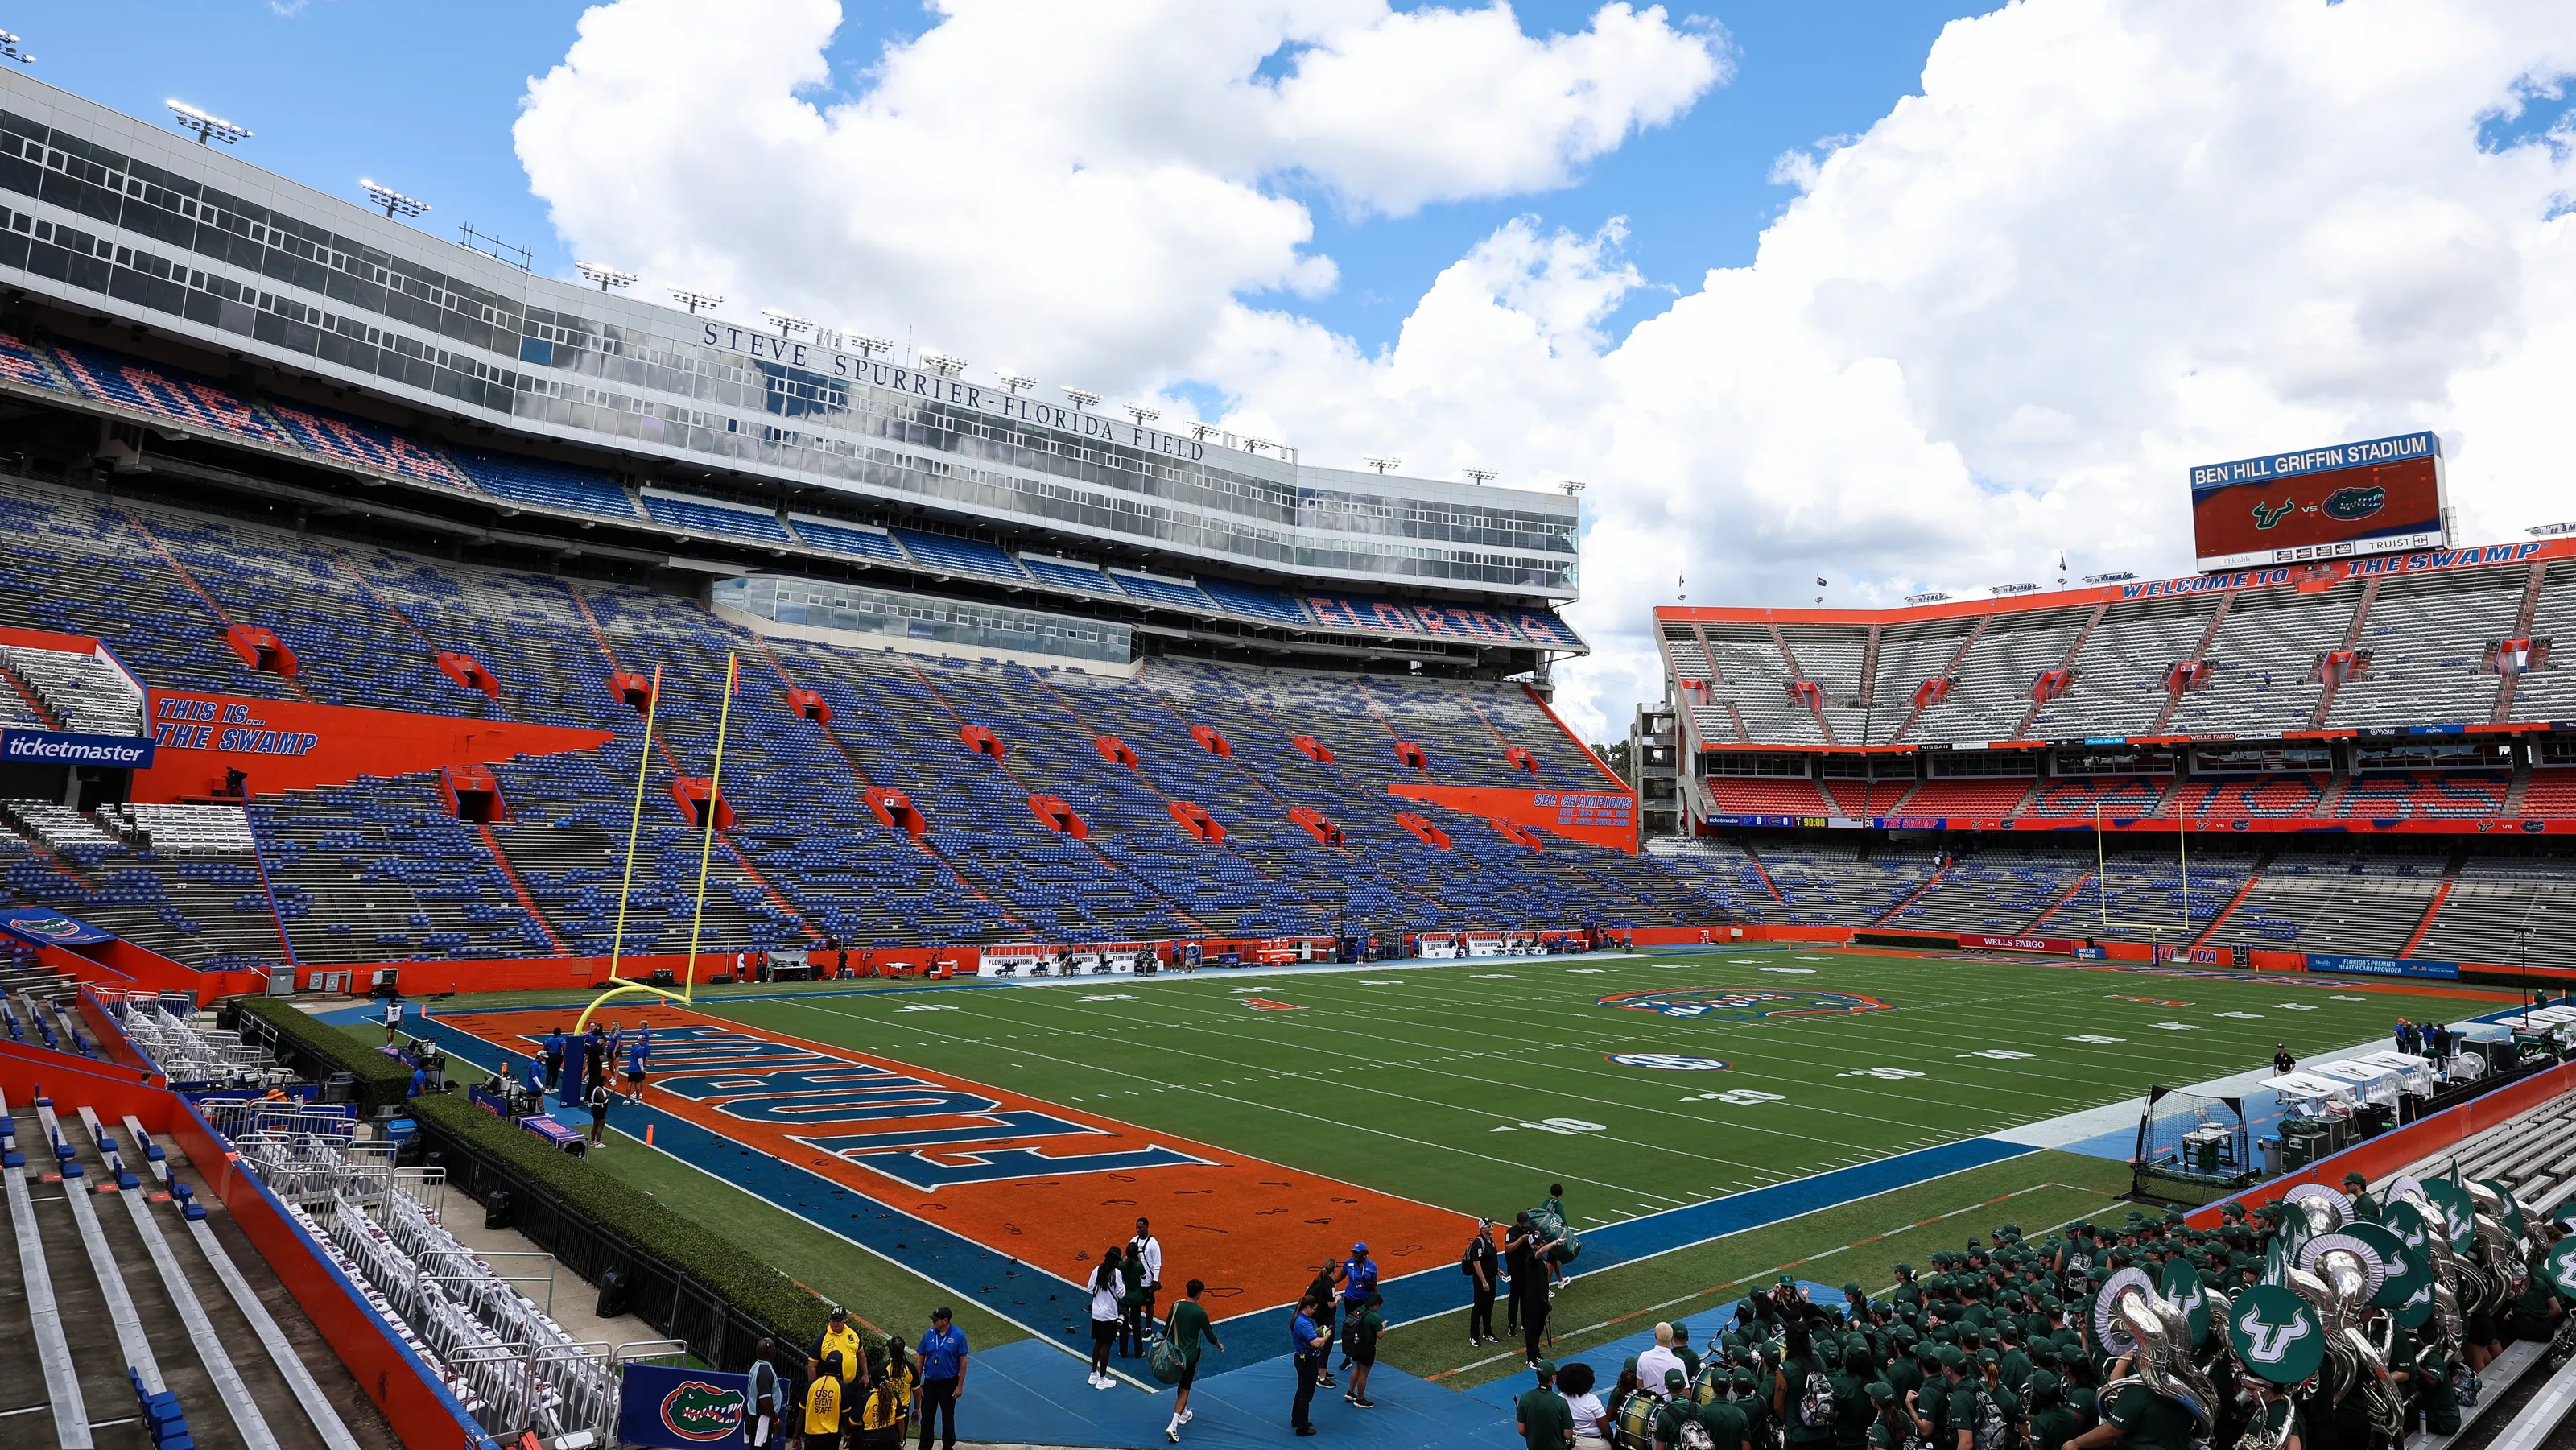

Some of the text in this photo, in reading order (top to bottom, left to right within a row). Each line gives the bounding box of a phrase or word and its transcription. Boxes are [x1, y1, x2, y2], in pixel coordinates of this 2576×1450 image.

[704, 322, 807, 366] STEVE
[1133, 427, 1204, 461] FIELD
[2195, 436, 2427, 485] BEN HILL GRIFFIN STADIUM
[2301, 505, 2318, 513] VS
[2368, 538, 2410, 550] TRUIST
[2122, 542, 2541, 600] WELCOME TO THE SWAMP
[1307, 597, 1563, 645] FLORIDA
[156, 698, 266, 726] THIS IS...
[155, 724, 319, 756] THE SWAMP
[10, 737, 145, 762] ticketmaster
[2033, 770, 2505, 818] GATORS
[1534, 793, 1633, 809] SEC CHAMPIONS
[1756, 816, 1761, 825] 0
[1783, 817, 1789, 825] 0
[1803, 817, 1826, 827] 90:00
[1865, 819, 1874, 828] 25
[1882, 819, 1938, 829] THE SWAMP
[1984, 938, 2045, 948] WELLS FARGO
[2343, 958, 2370, 966] FLORIDA'S
[1519, 1117, 1607, 1135] 10
[815, 1398, 832, 1407] EVENT
[815, 1406, 832, 1415] STAFF
